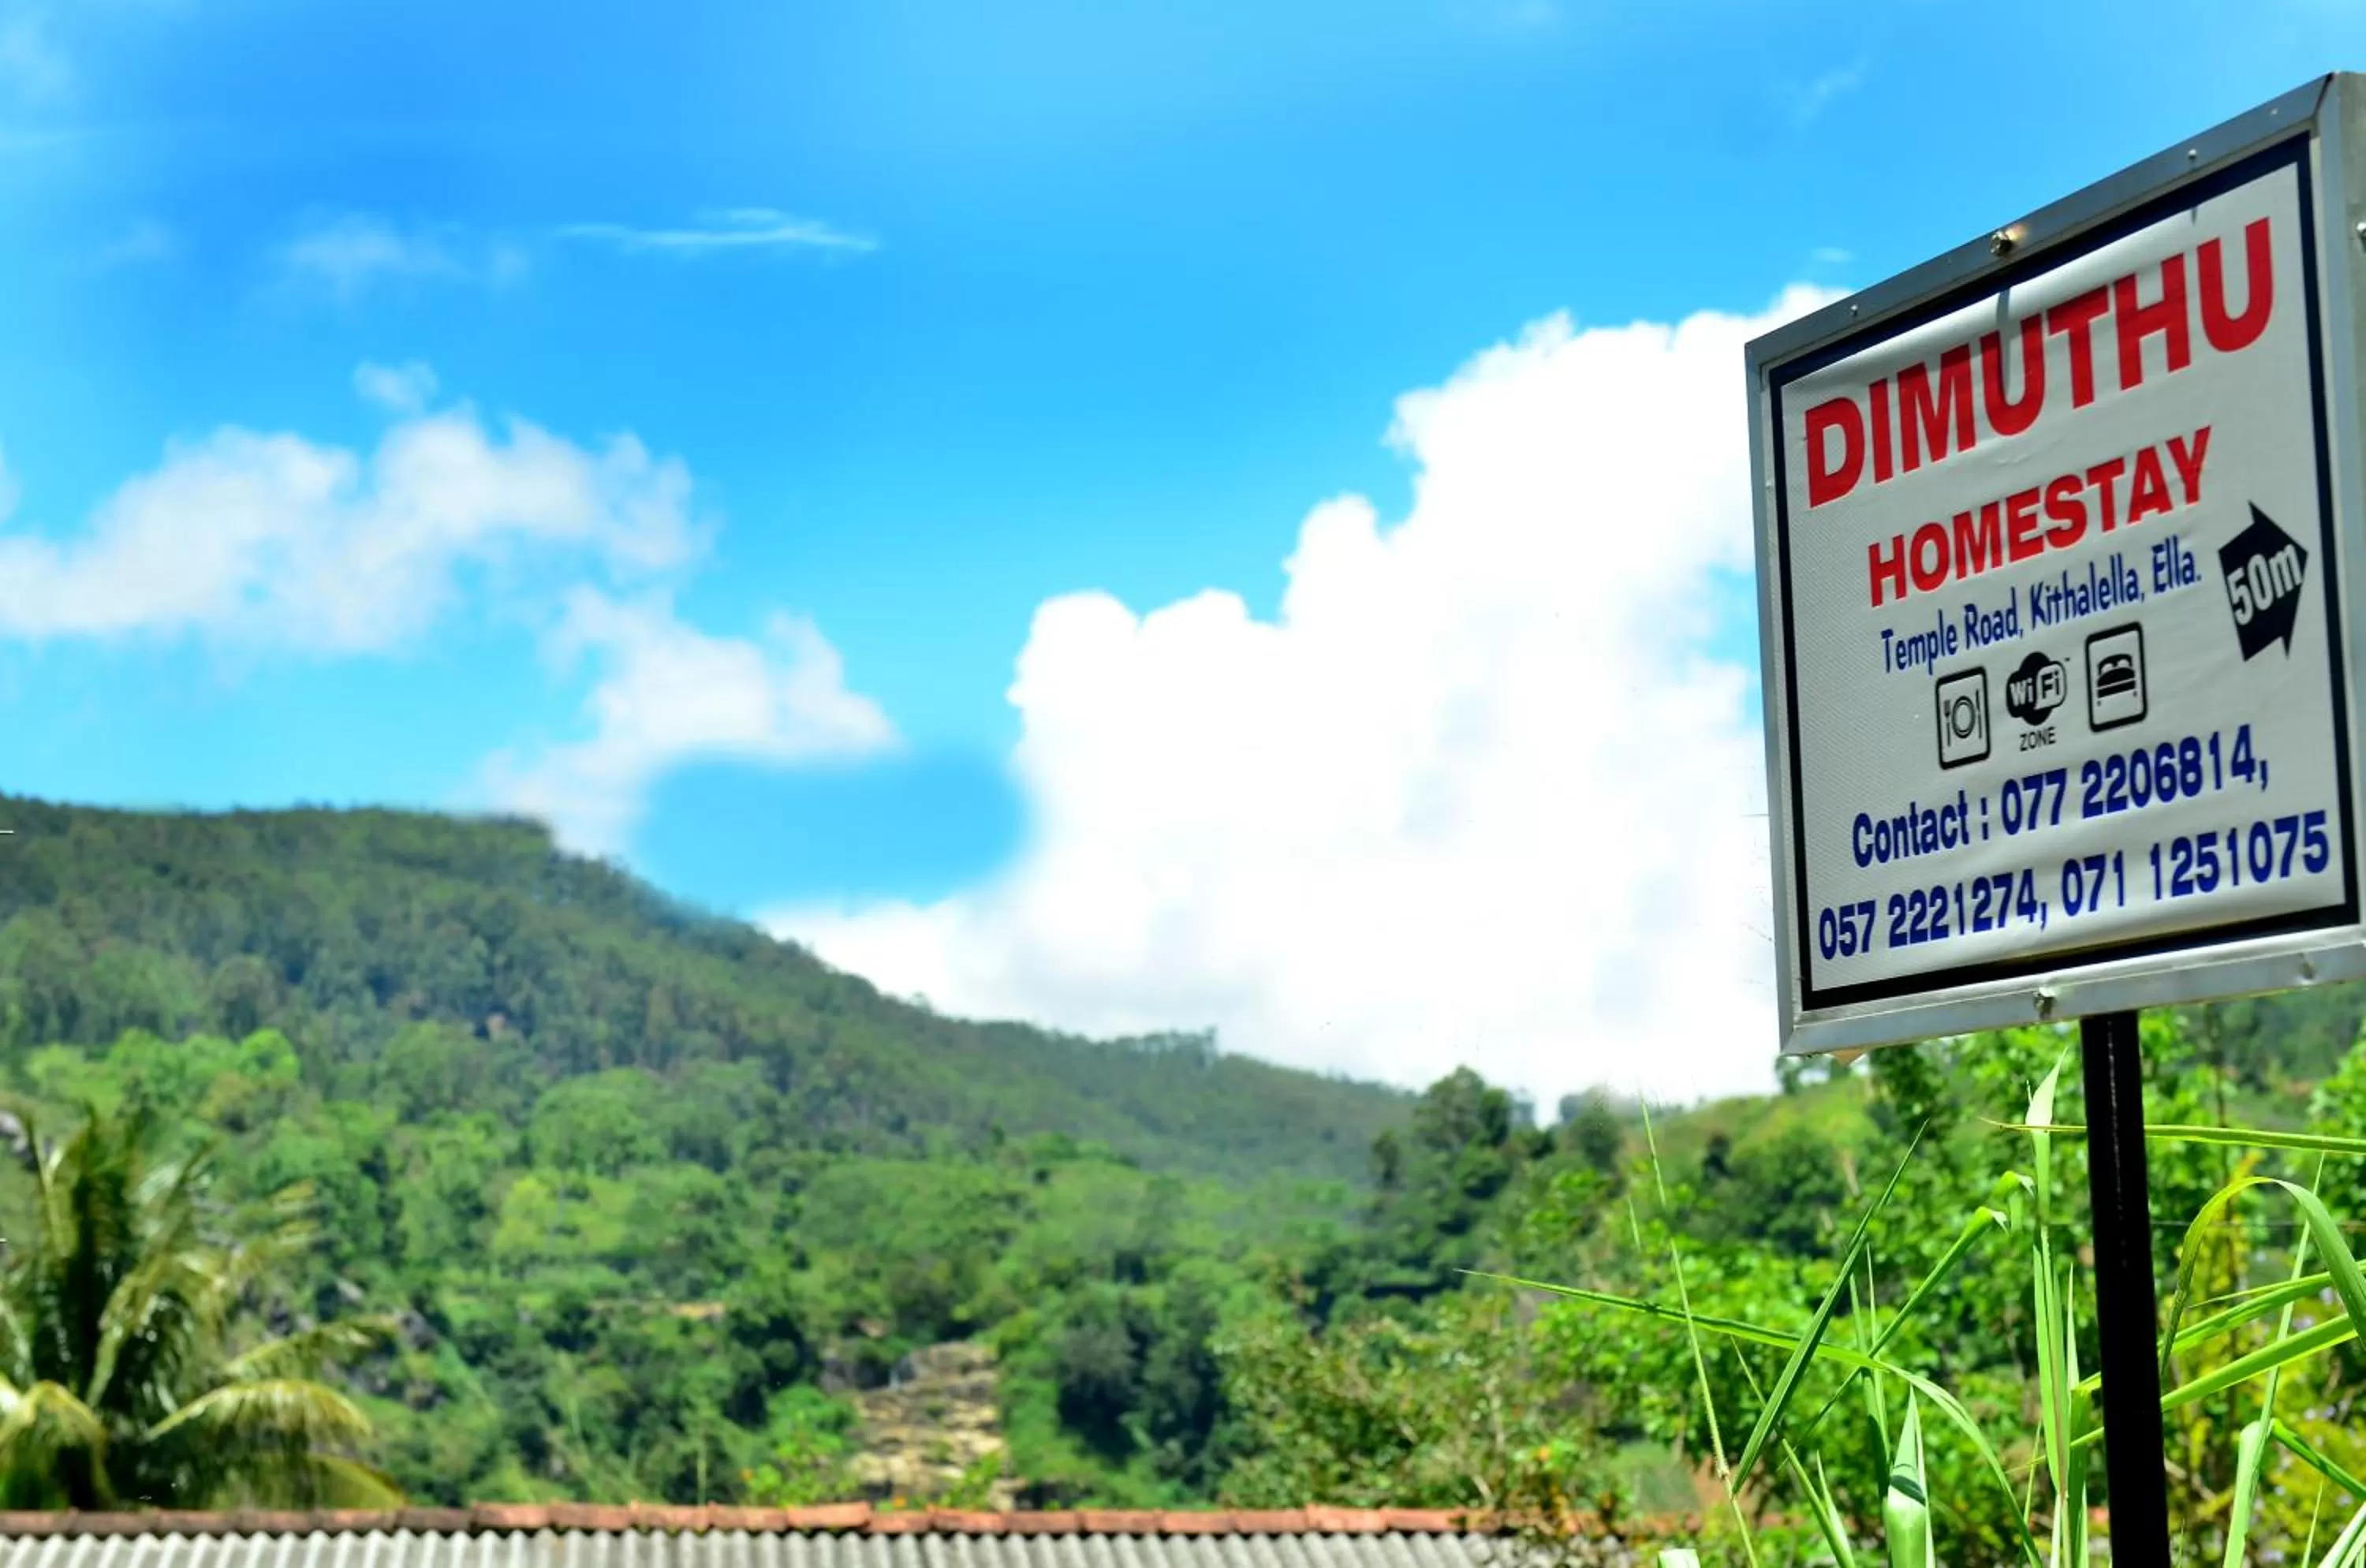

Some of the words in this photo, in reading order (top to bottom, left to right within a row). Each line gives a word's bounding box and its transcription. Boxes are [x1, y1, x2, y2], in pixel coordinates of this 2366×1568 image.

[1804, 217, 2273, 508] DIMUTHU
[1868, 426, 2211, 607] HOMESTAY
[2226, 543, 2303, 625] 50m
[1881, 609, 1958, 675] Temple
[1965, 586, 2024, 650] Road,
[2030, 553, 2145, 631] Kithalella,
[2152, 534, 2202, 593] Ella.
[1853, 790, 1970, 867] Contact
[2001, 767, 2068, 835] 077
[2081, 723, 2269, 819] 2206814,
[2019, 726, 2057, 751] ZONE
[1819, 900, 1876, 960] 057
[1887, 868, 2047, 948] 2221274,
[2062, 850, 2127, 917] 071
[2149, 809, 2329, 903] 1251075
